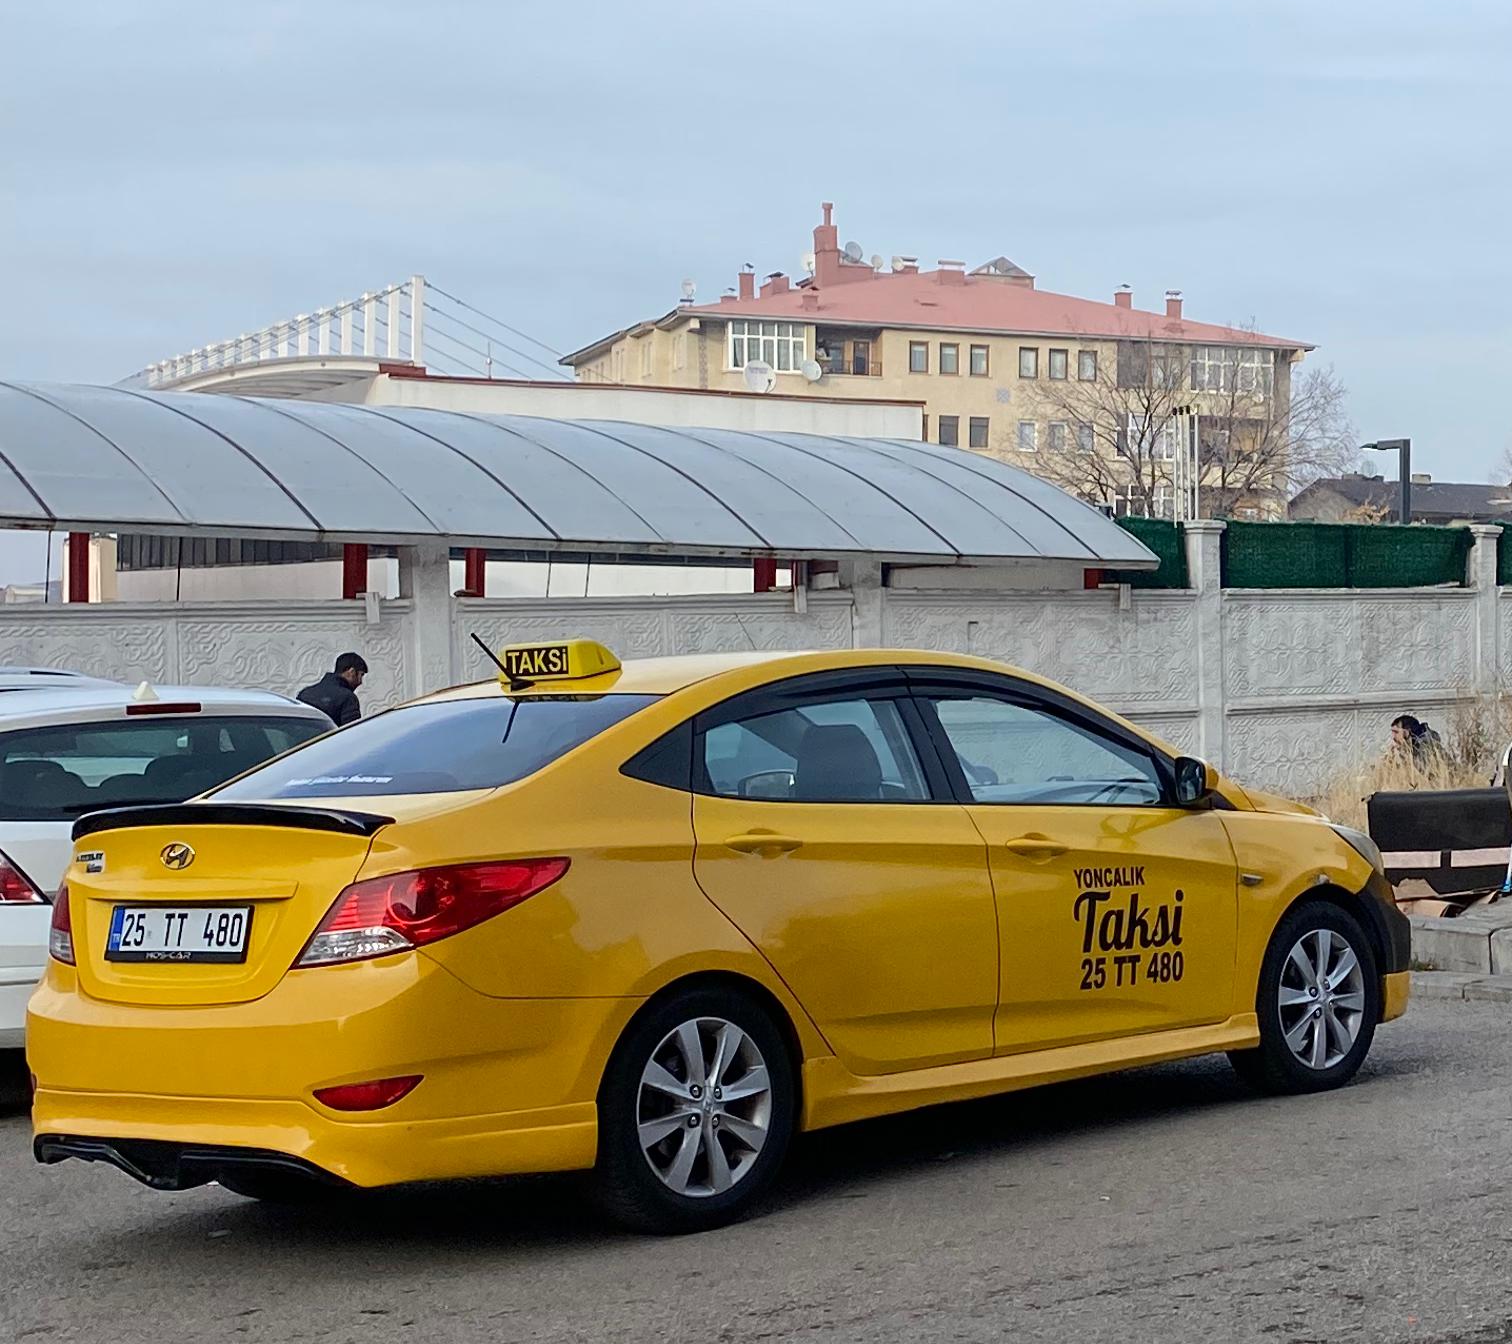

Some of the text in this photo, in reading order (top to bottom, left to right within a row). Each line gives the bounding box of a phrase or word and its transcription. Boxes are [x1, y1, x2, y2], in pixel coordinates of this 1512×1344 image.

[1073, 866, 1145, 889] YONCALIK
[121, 912, 243, 947] 25 TT 480
[1073, 889, 1184, 953] Taksi
[1080, 951, 1184, 990] 25 TT 480
